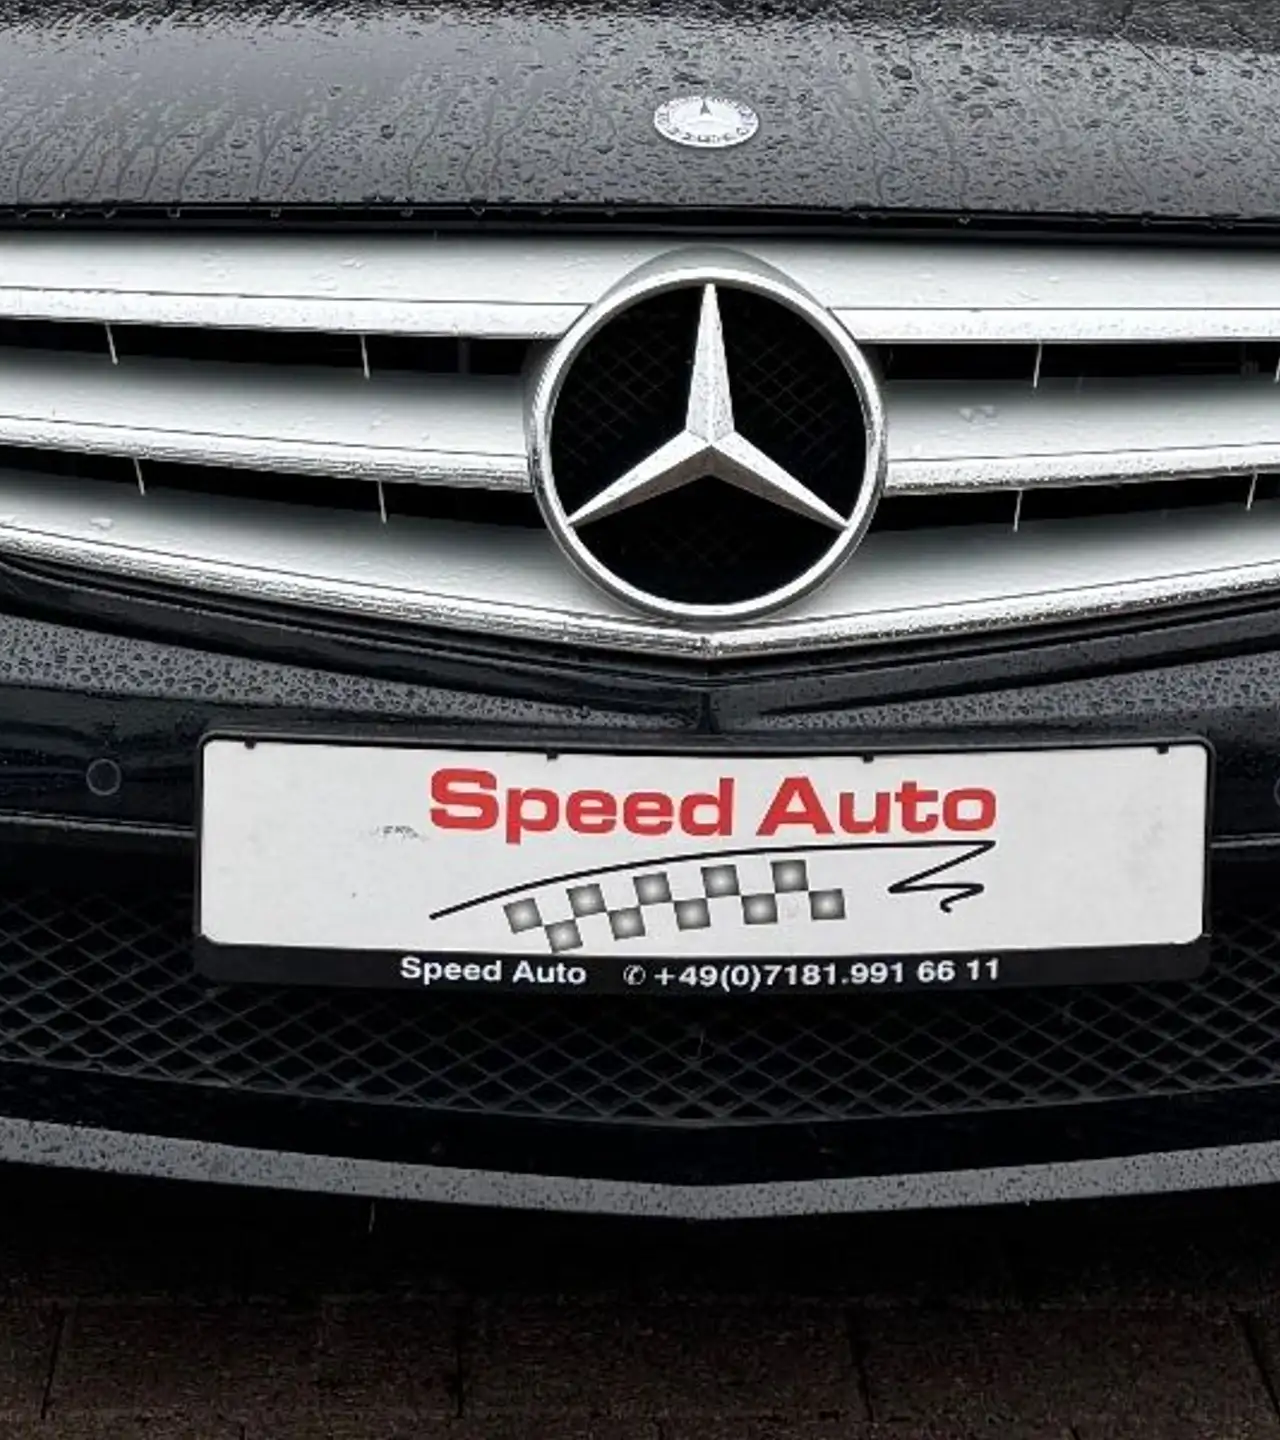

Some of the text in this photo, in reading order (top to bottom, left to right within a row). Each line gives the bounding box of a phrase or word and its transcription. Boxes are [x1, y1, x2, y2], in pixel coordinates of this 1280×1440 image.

[429, 767, 997, 846] Speed Auto
[400, 956, 588, 987] Speed Auto
[916, 960, 956, 984] 66
[965, 957, 999, 981] 11
